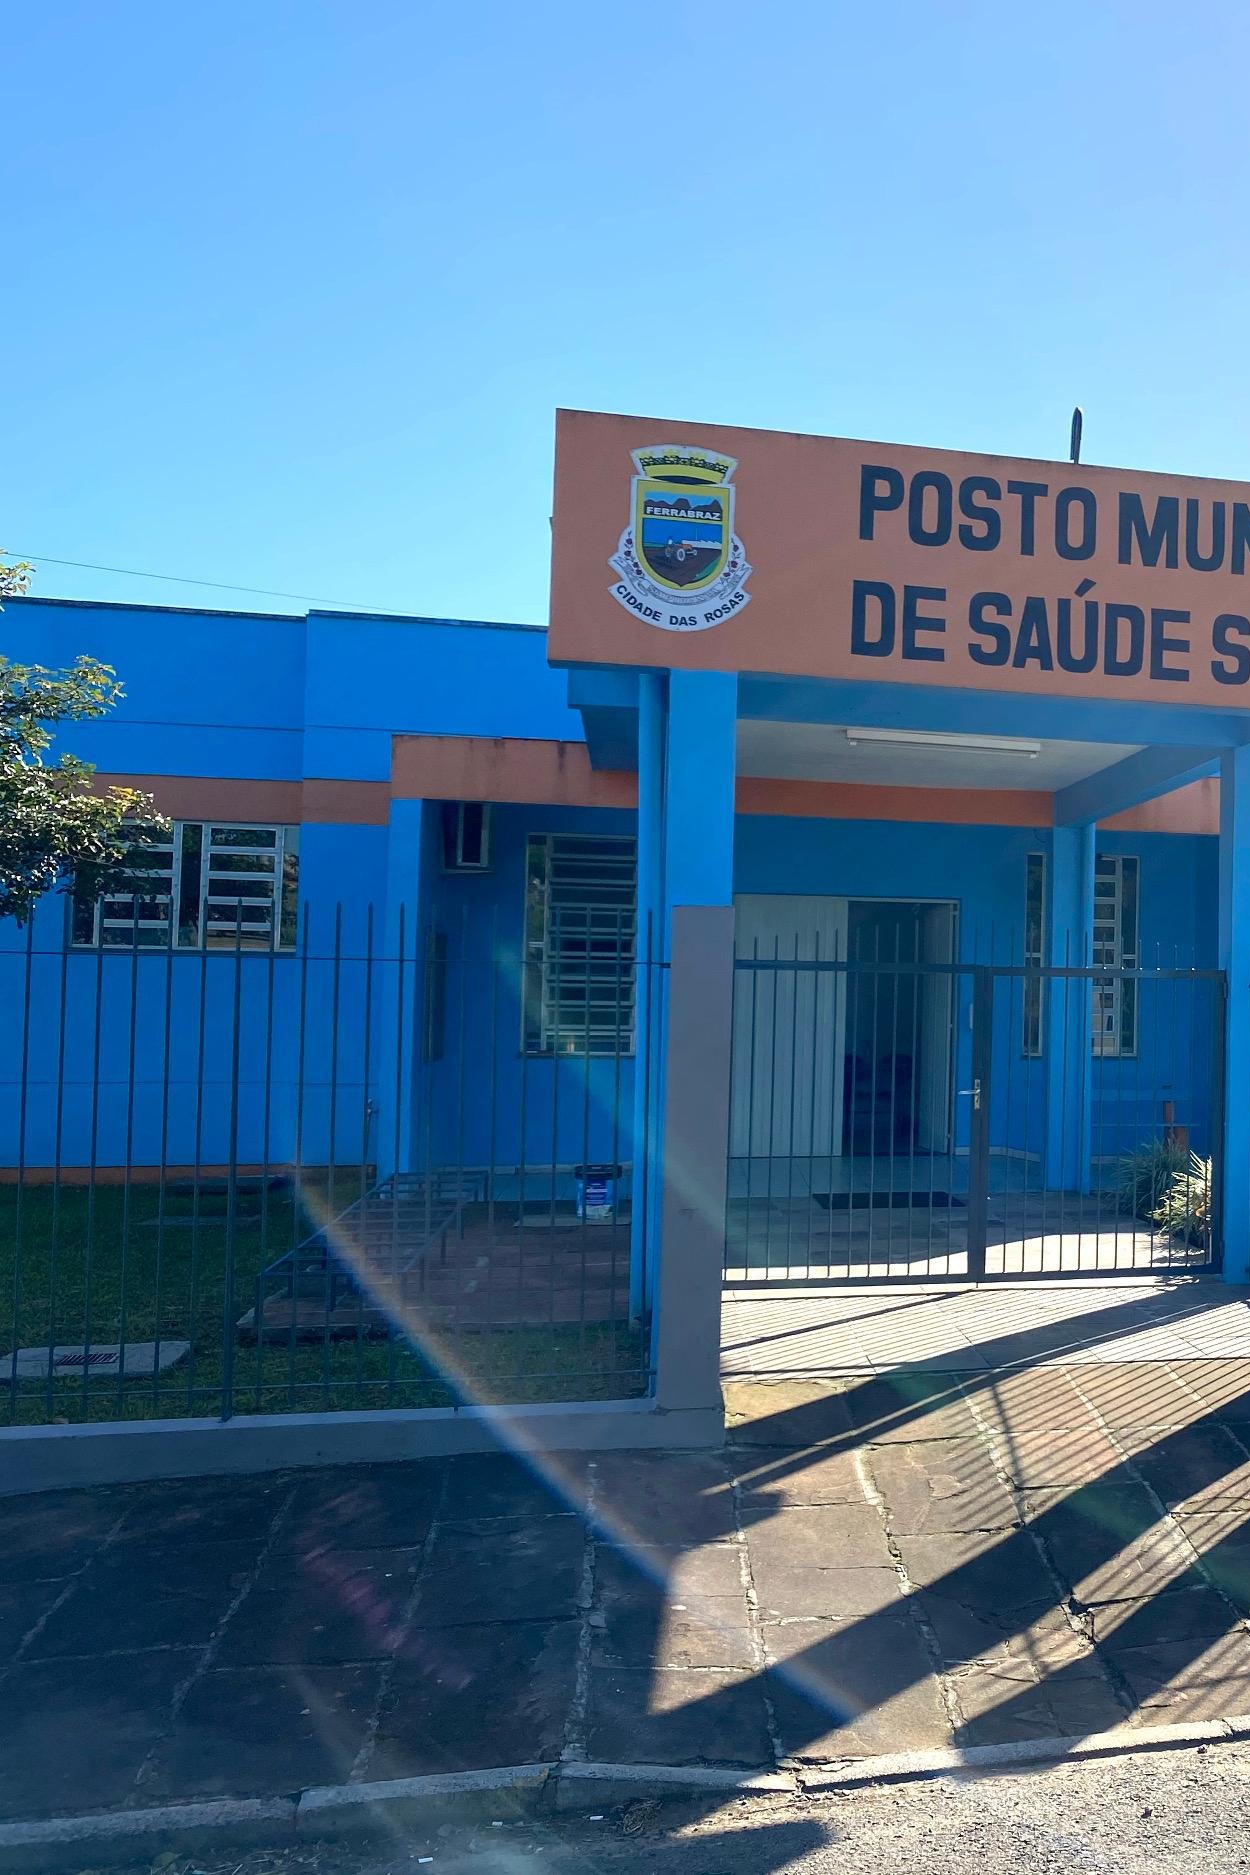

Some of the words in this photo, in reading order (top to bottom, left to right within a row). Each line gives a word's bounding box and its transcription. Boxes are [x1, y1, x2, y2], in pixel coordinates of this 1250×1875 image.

[646, 506, 722, 521] FERRABRAZ
[858, 463, 1098, 561] POSTO
[616, 584, 663, 622] CIDADE
[669, 615, 698, 627] DAS
[703, 591, 745, 623] ROSAS
[850, 579, 947, 663] DE
[967, 577, 1191, 683] SAÚDE
